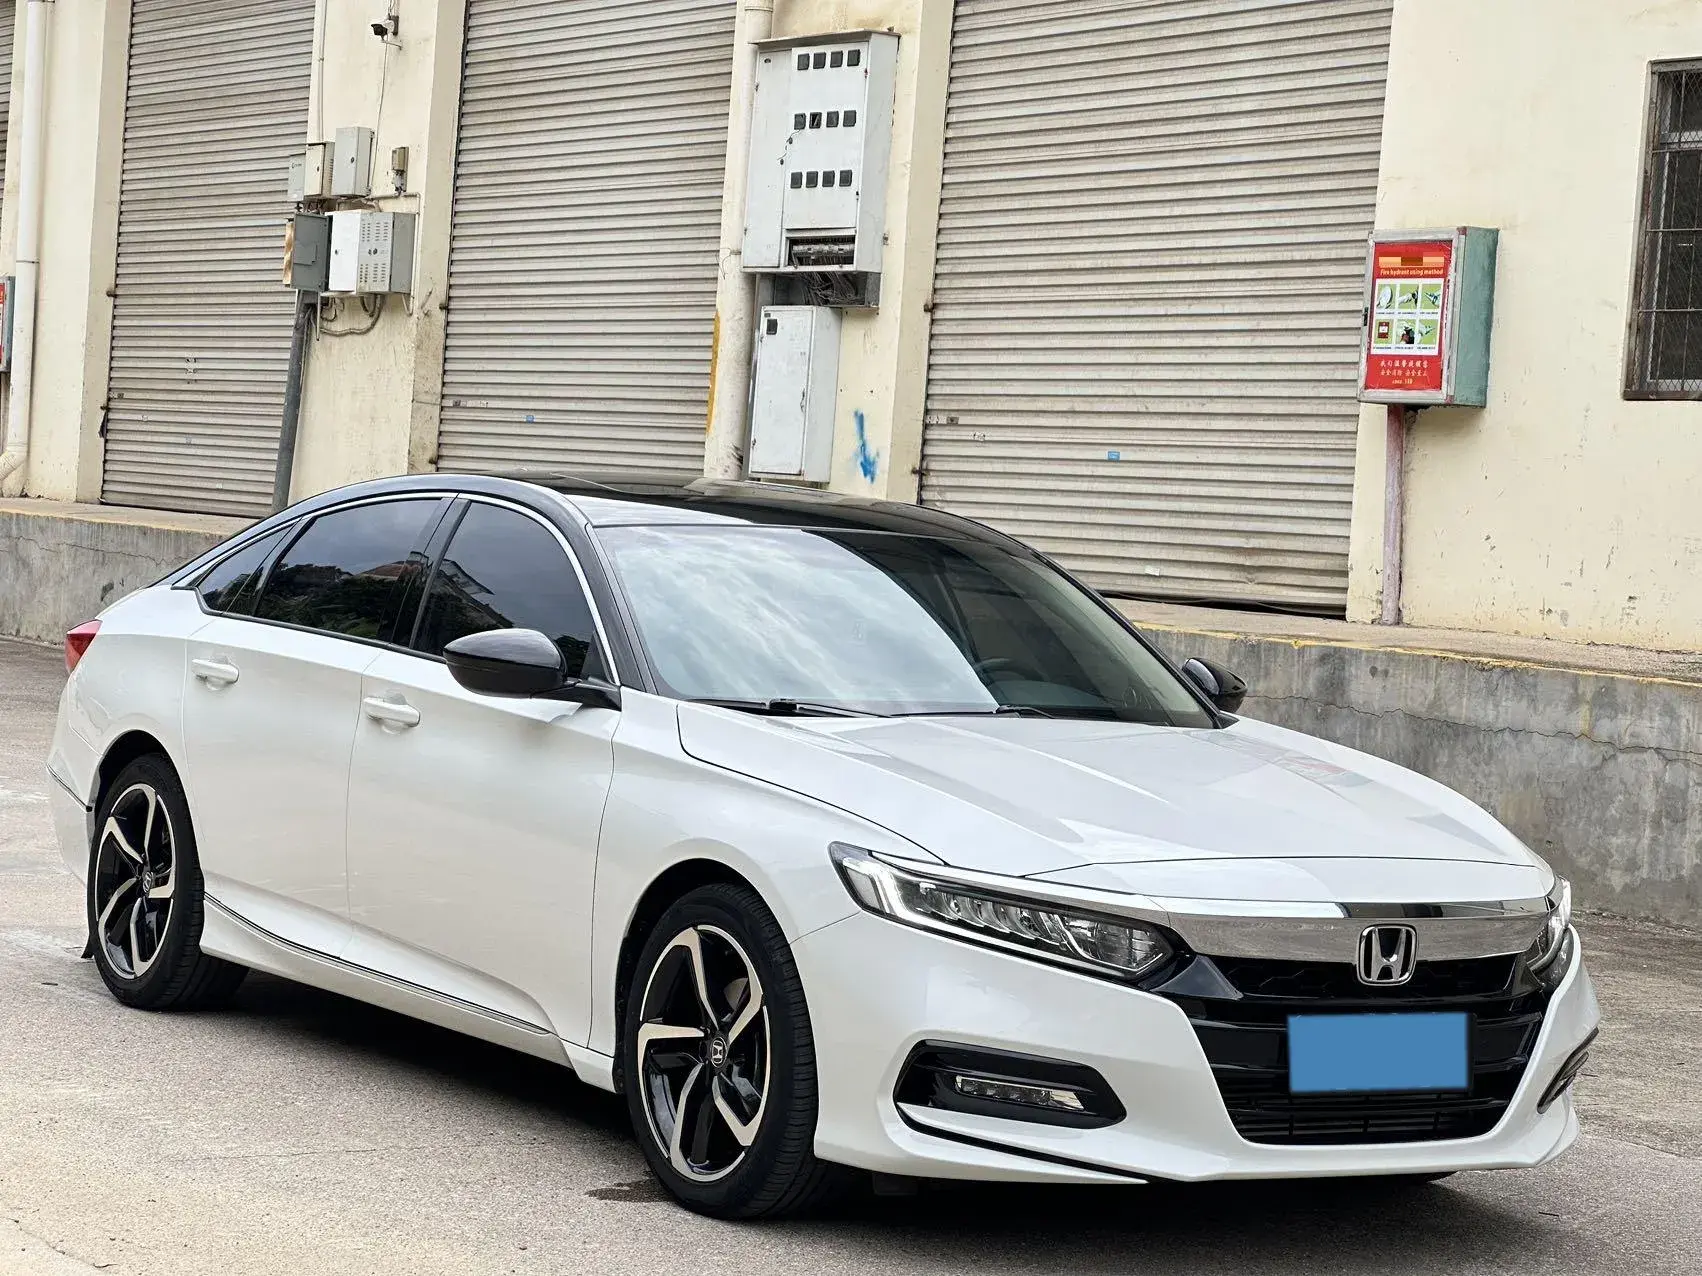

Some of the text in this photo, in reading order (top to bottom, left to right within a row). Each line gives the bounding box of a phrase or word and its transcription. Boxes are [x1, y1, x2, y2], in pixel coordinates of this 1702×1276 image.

[1380, 267, 1443, 277] Fire hydrant using method
